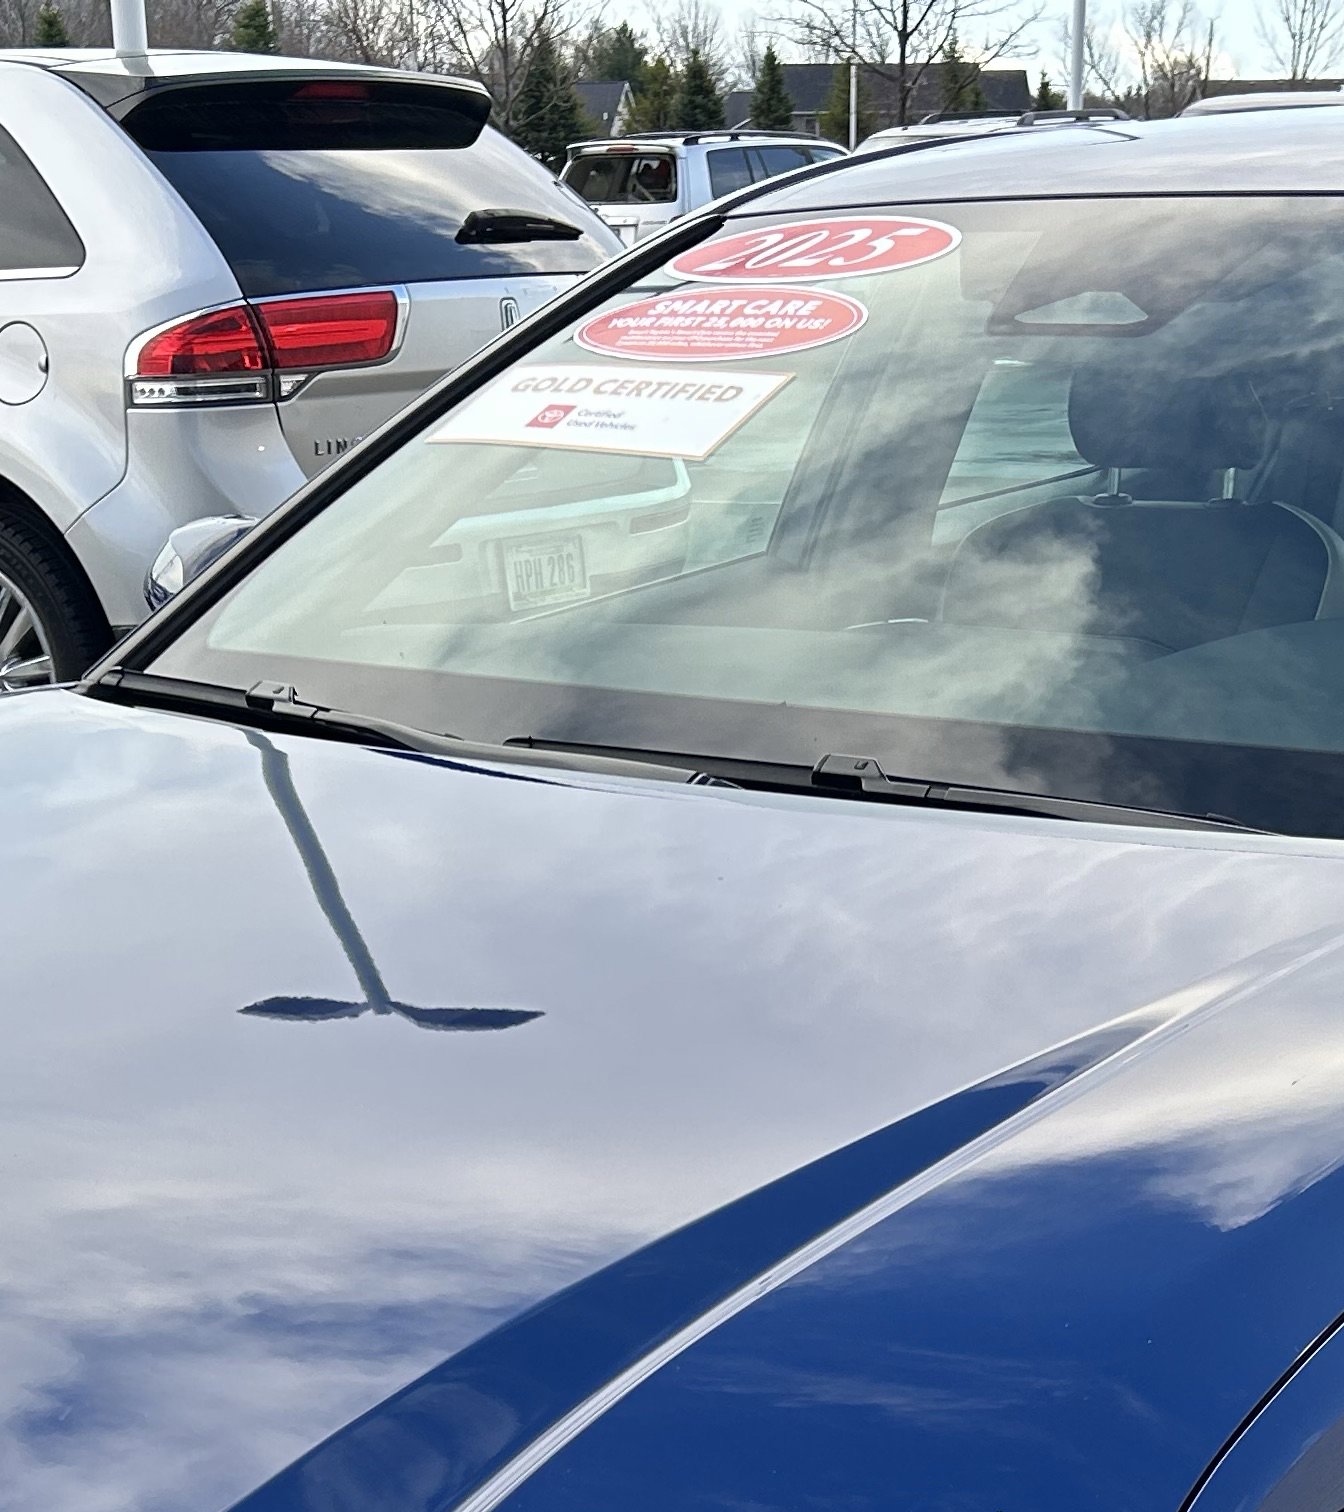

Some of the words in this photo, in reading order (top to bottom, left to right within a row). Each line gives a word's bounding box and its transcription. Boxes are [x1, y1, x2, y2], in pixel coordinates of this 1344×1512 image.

[694, 228, 930, 272] 2025
[647, 300, 744, 315] SMART
[744, 300, 825, 315] CARE
[608, 317, 656, 329] YOUR
[654, 317, 704, 328] FIRST
[764, 318, 798, 330] ON
[796, 318, 833, 330] US!
[511, 377, 594, 396] GOLD
[592, 379, 744, 403] CERTIFIED
[577, 408, 626, 419] Certified
[566, 418, 593, 428] Used
[593, 420, 638, 431] Vehicles
[513, 558, 544, 593] HPH
